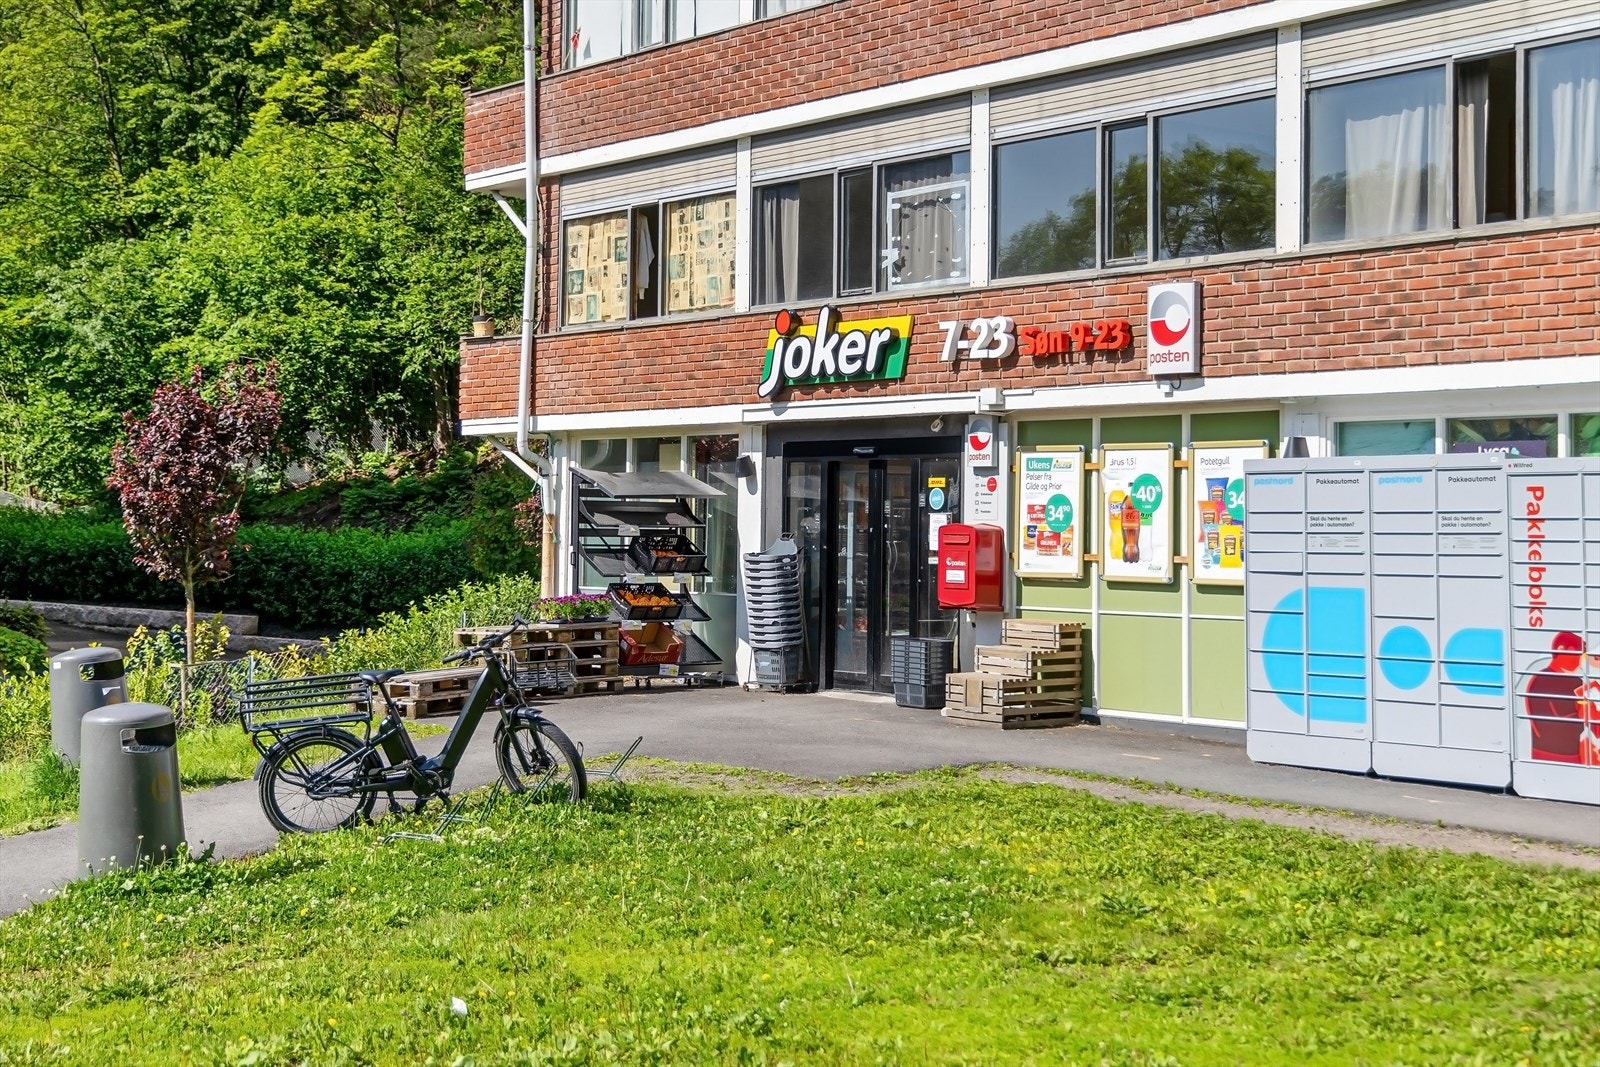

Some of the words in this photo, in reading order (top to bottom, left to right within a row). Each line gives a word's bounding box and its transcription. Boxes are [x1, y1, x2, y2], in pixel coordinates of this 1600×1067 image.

[938, 316, 1013, 362] 7-23
[1019, 326, 1066, 357] Søn
[1069, 318, 1127, 352] 9-23
[758, 305, 893, 398] joker
[1149, 349, 1190, 365] posten
[969, 452, 990, 461] posten
[1200, 456, 1230, 467] Potetgull
[1028, 460, 1050, 469] Ukens
[1026, 473, 1043, 481] Pølser
[1043, 472, 1052, 481] fra
[1254, 477, 1294, 486] postnord
[1378, 475, 1423, 485] postnord
[1448, 475, 1497, 483] Pakkeautomat
[1025, 482, 1040, 490] Gilde
[1040, 483, 1048, 492] og
[1048, 482, 1062, 490] Prior
[1315, 478, 1360, 486] Pakkeautomat
[1526, 486, 1547, 628] Pakkeboks
